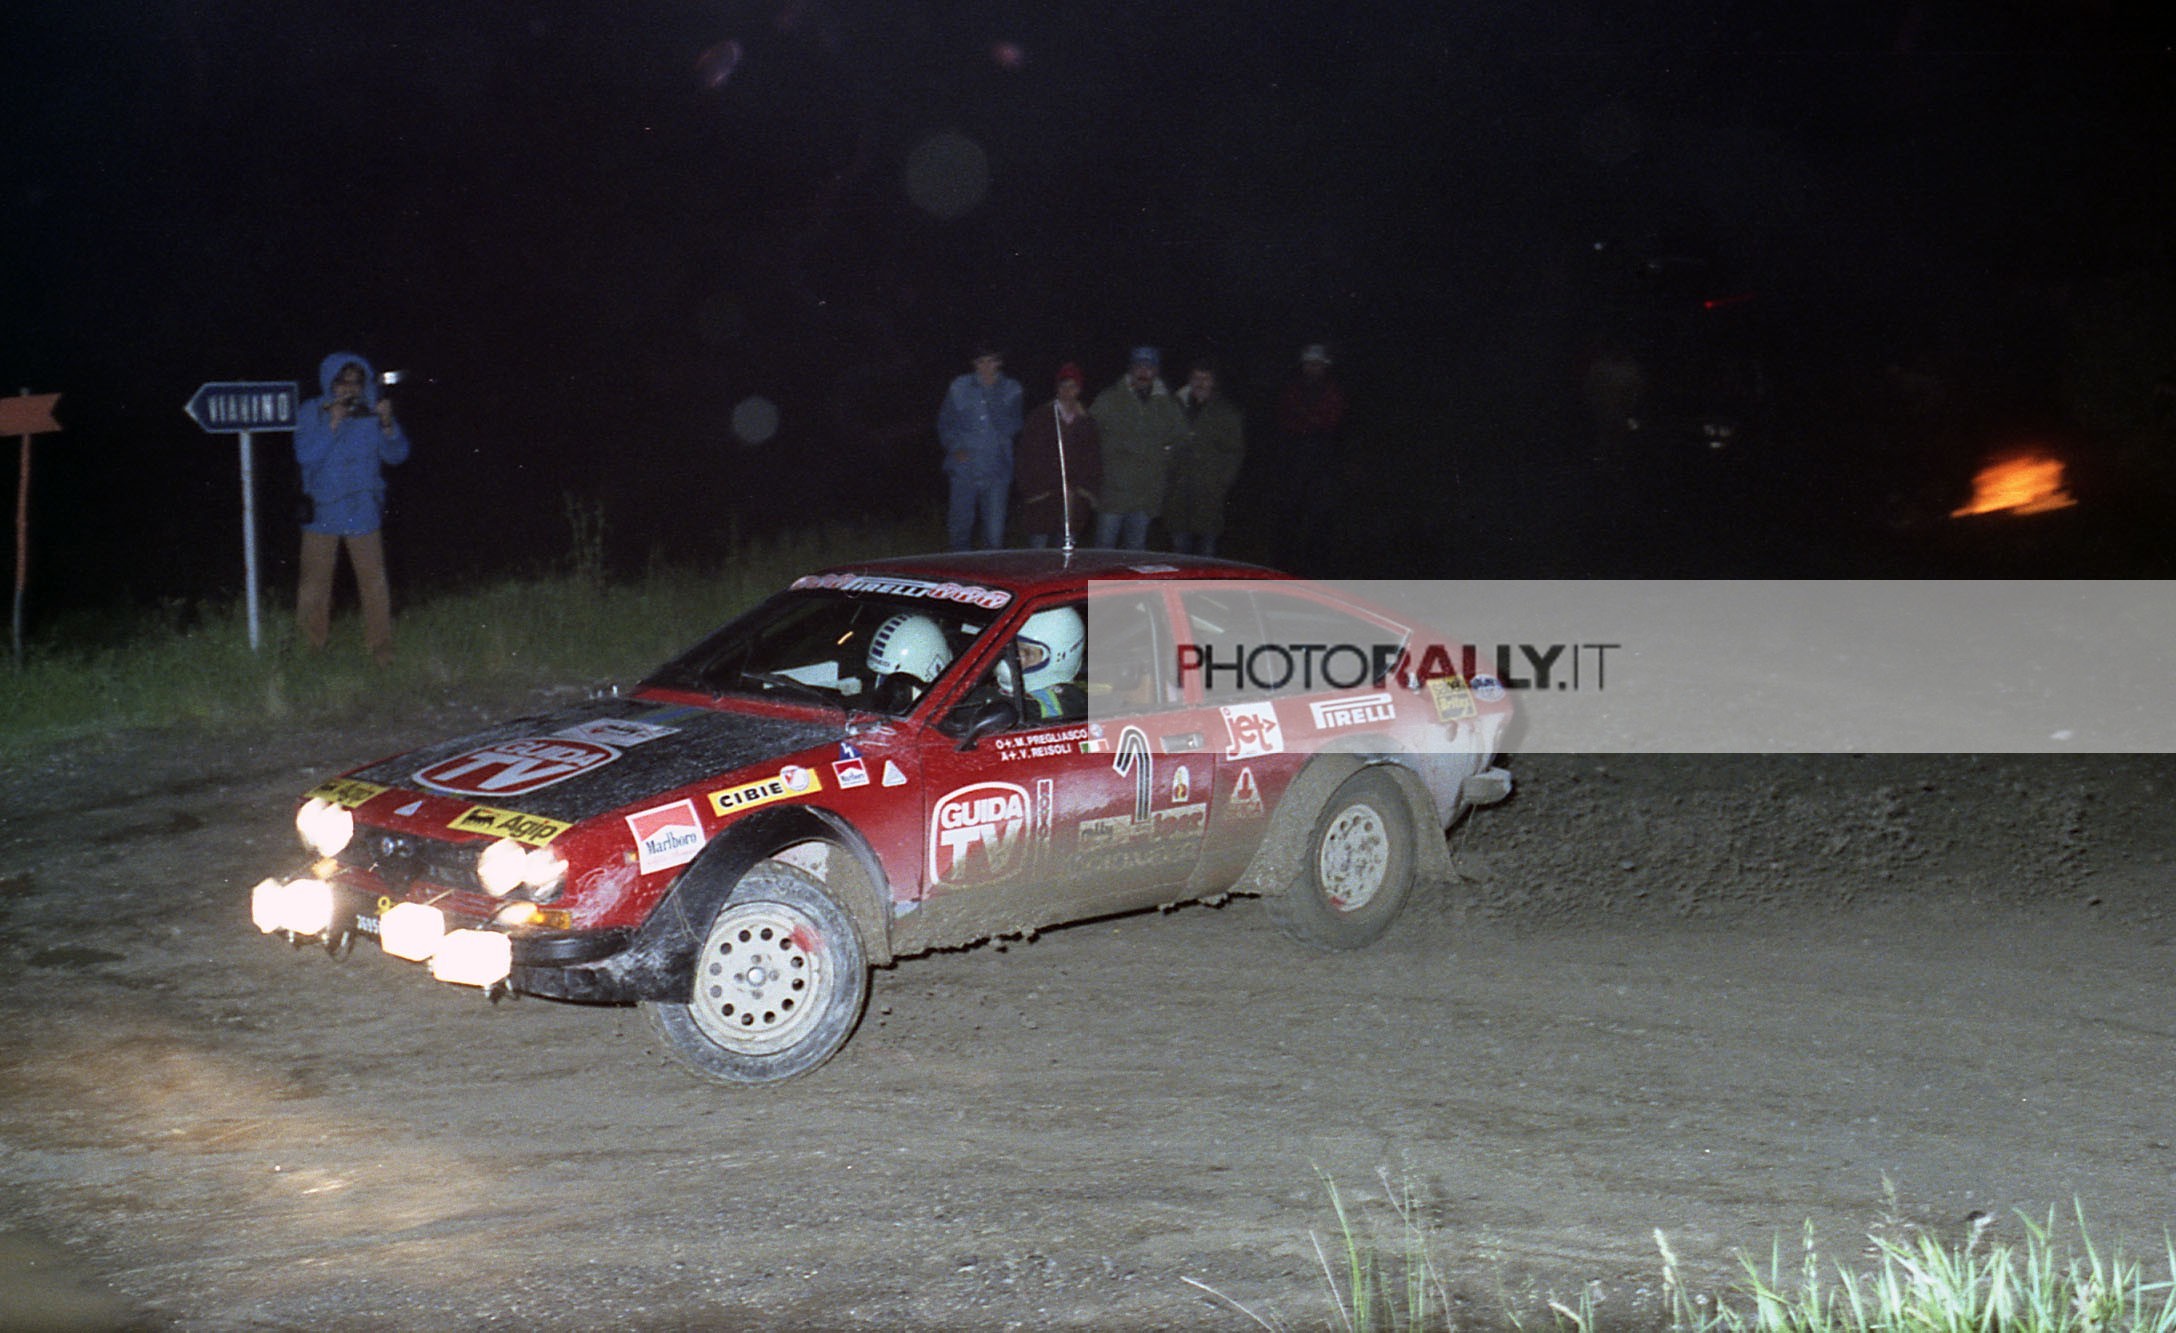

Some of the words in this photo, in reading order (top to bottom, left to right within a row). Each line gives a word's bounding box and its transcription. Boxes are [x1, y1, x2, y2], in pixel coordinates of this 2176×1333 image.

[841, 576, 938, 598] PIRELLI
[1309, 692, 1396, 729] PIRELLI
[495, 739, 608, 768] GUIDA
[430, 751, 582, 790] TV
[719, 782, 784, 809] CIBIE
[941, 793, 1024, 829] GUIDA
[496, 815, 559, 841] Agip
[645, 831, 698, 856] Marlboro
[940, 819, 1023, 880] TV
